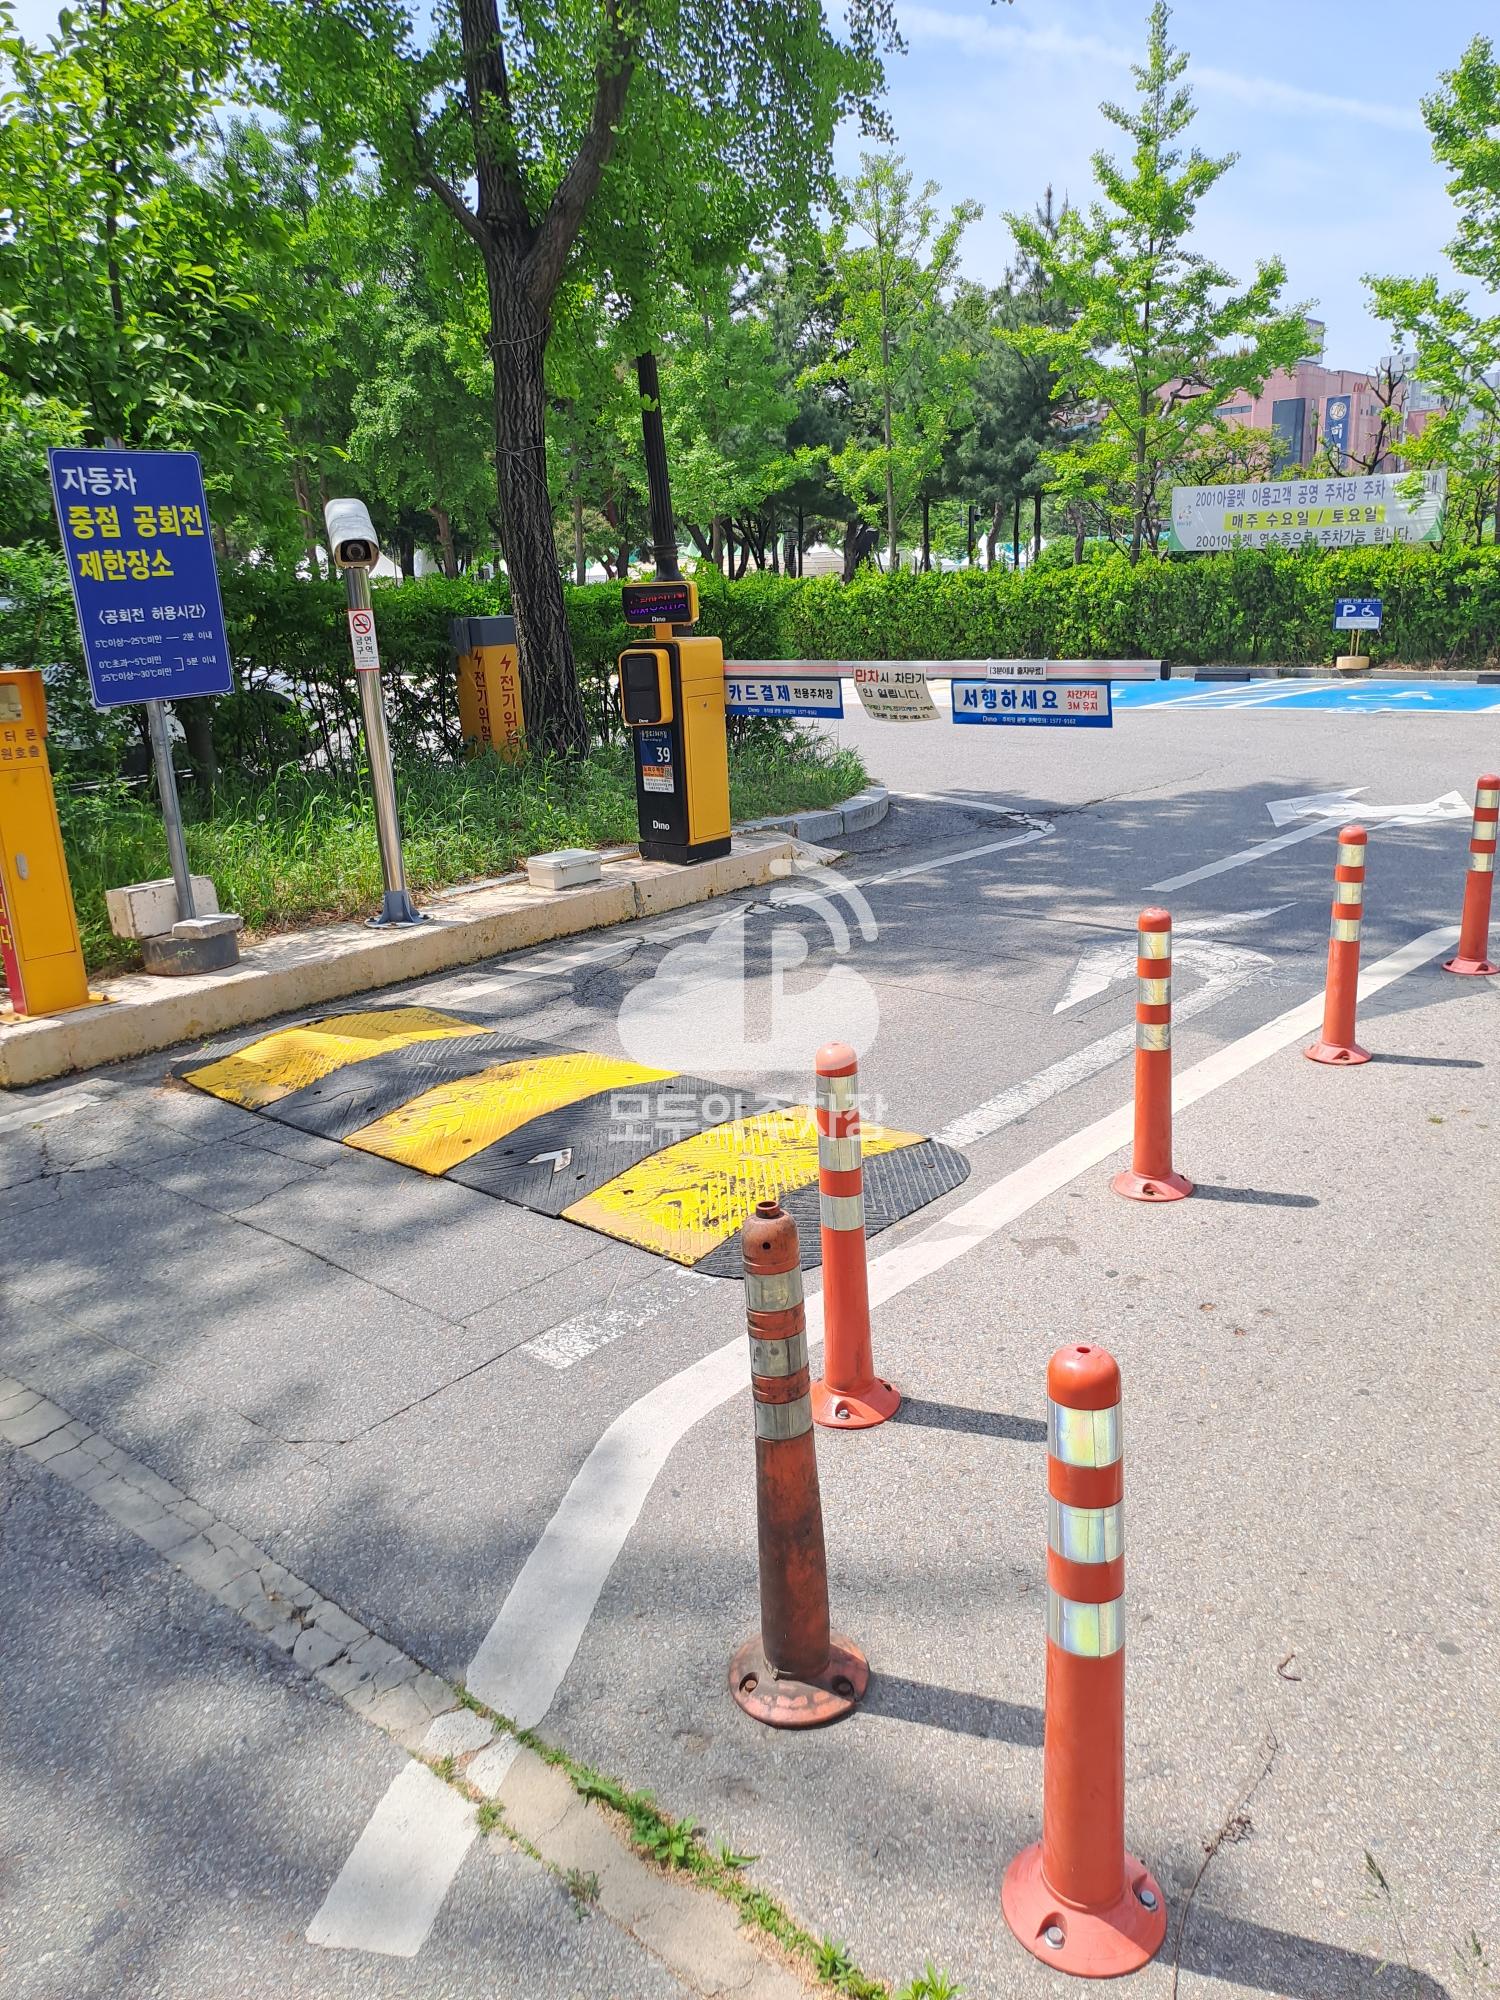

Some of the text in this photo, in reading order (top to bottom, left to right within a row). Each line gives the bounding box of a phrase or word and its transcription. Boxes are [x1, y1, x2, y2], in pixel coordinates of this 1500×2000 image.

[61, 467, 137, 496] 자동차
[1196, 489, 1246, 508] 2001아울렛
[1252, 486, 1292, 506] 이용고객
[1298, 484, 1318, 504] 공영
[1325, 481, 1357, 502] 주차장
[1363, 480, 1386, 500] 주차
[68, 505, 205, 539] 중점 공회전
[1232, 513, 1258, 528] 매주
[1266, 511, 1309, 527] 수요일
[1332, 506, 1377, 523] 토요일
[1321, 528, 1366, 544] 주차가능
[77, 549, 174, 582] 제한장소
[1343, 605, 1357, 616] P
[198, 631, 213, 640] 이내
[355, 636, 372, 645] 금연
[356, 645, 374, 654] 구역
[202, 655, 217, 664] 이내
[855, 669, 925, 684] 만차시 차단기
[728, 684, 833, 702] 카드결제 전용주차장
[863, 688, 873, 697] 안
[963, 689, 1059, 710] 서행하세요
[1066, 690, 1098, 700] 차간거리
[1067, 702, 1098, 711] 3M 유지
[656, 747, 671, 763] 39
[652, 820, 670, 831] Dino
